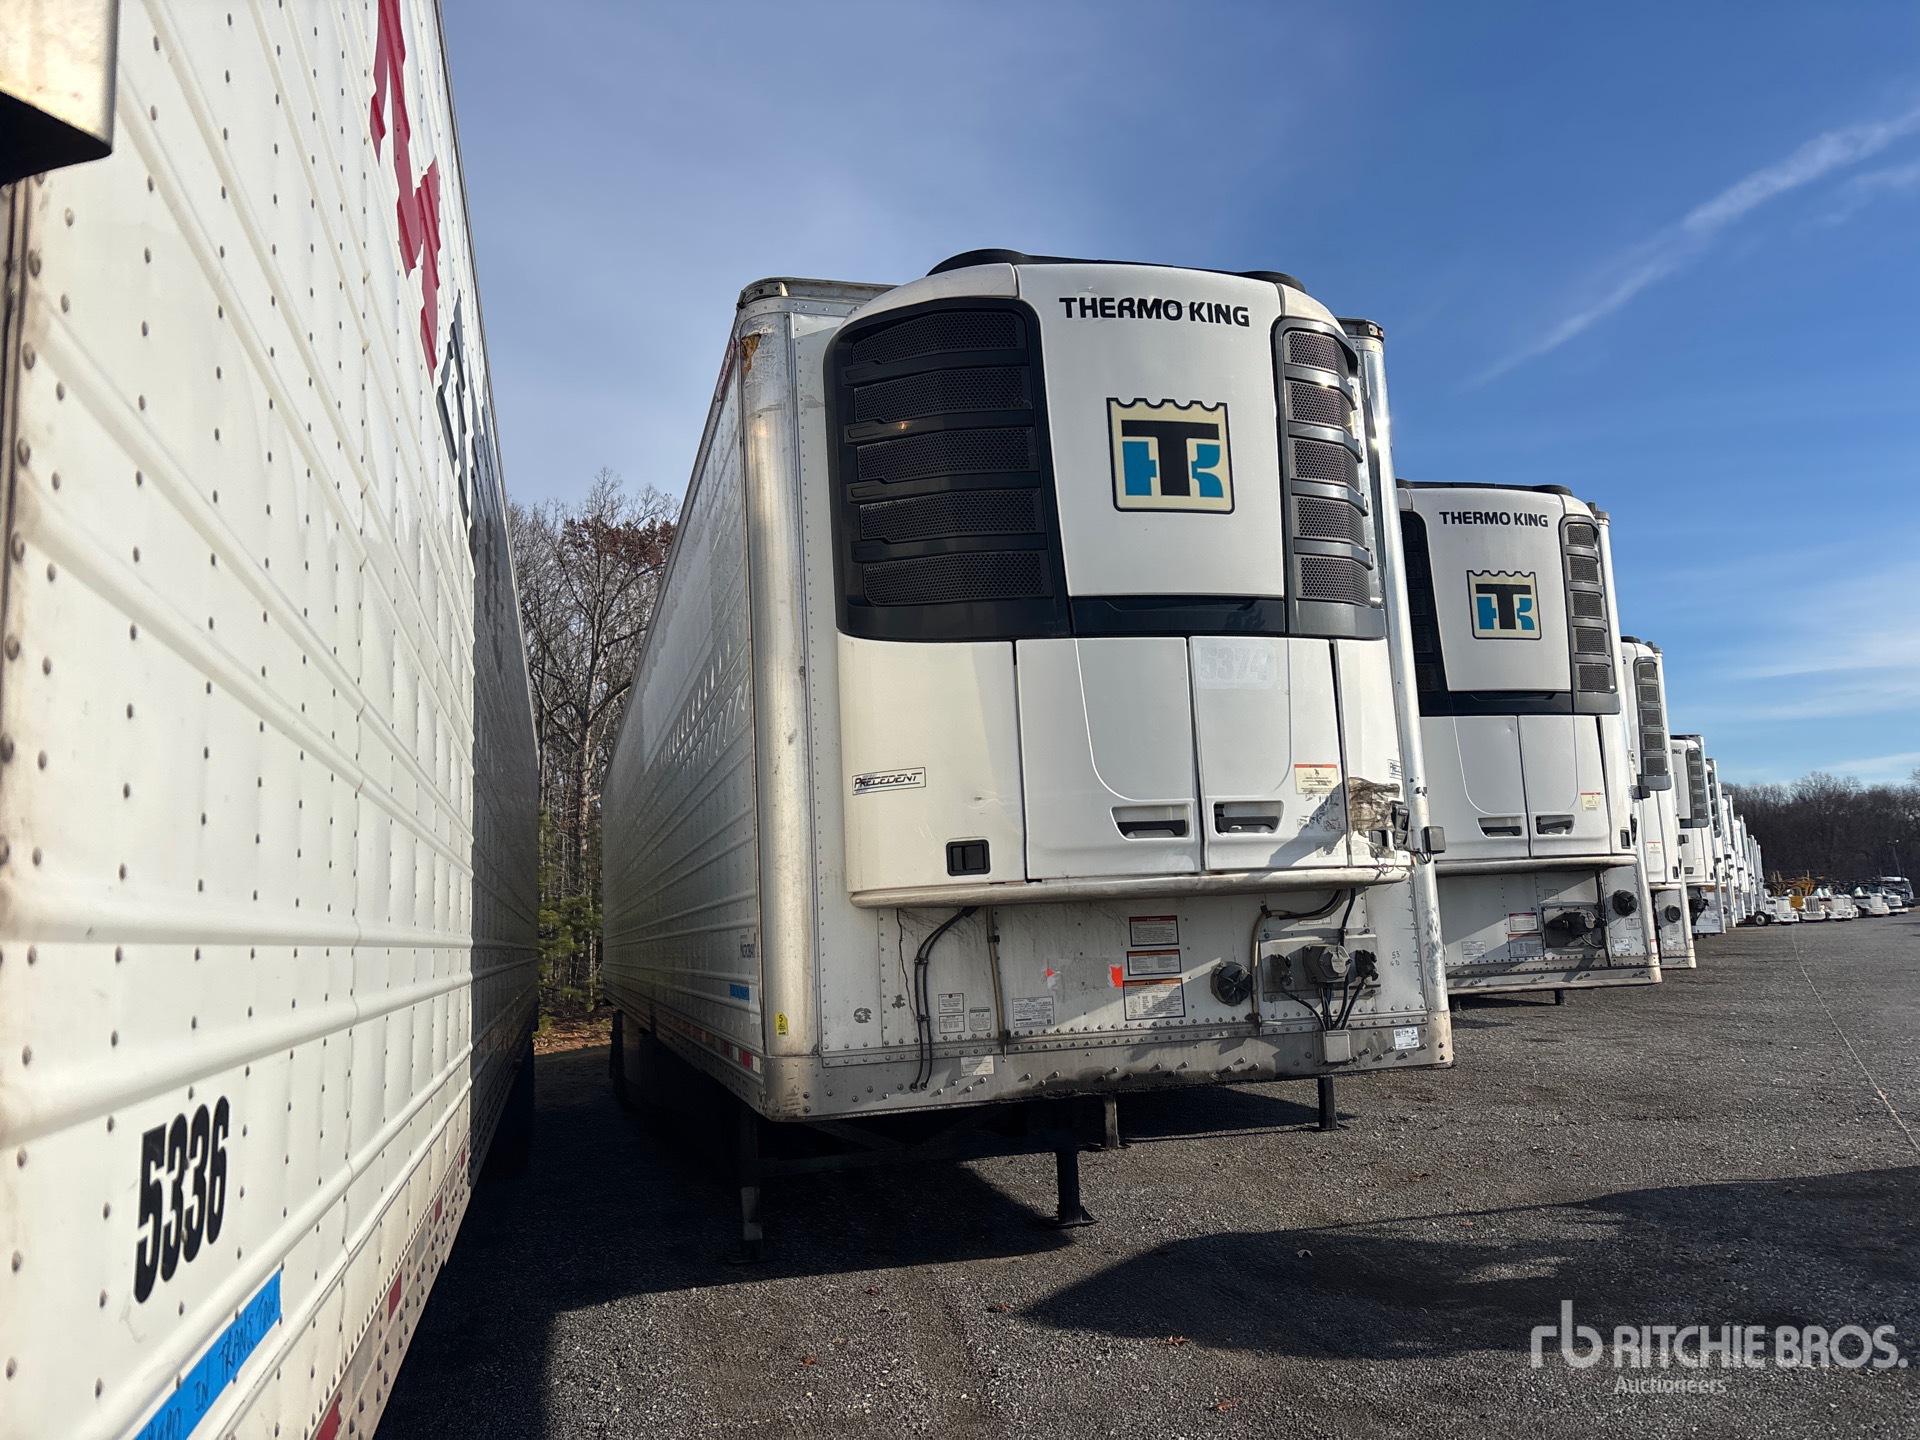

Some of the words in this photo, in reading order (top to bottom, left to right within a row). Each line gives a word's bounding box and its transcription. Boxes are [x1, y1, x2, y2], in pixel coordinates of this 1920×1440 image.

[1059, 297, 1183, 321] THERMO
[1189, 302, 1250, 327] KING
[1439, 511, 1511, 526] THERMO
[1514, 512, 1548, 528] KING
[134, 1095, 229, 1303] 5336
